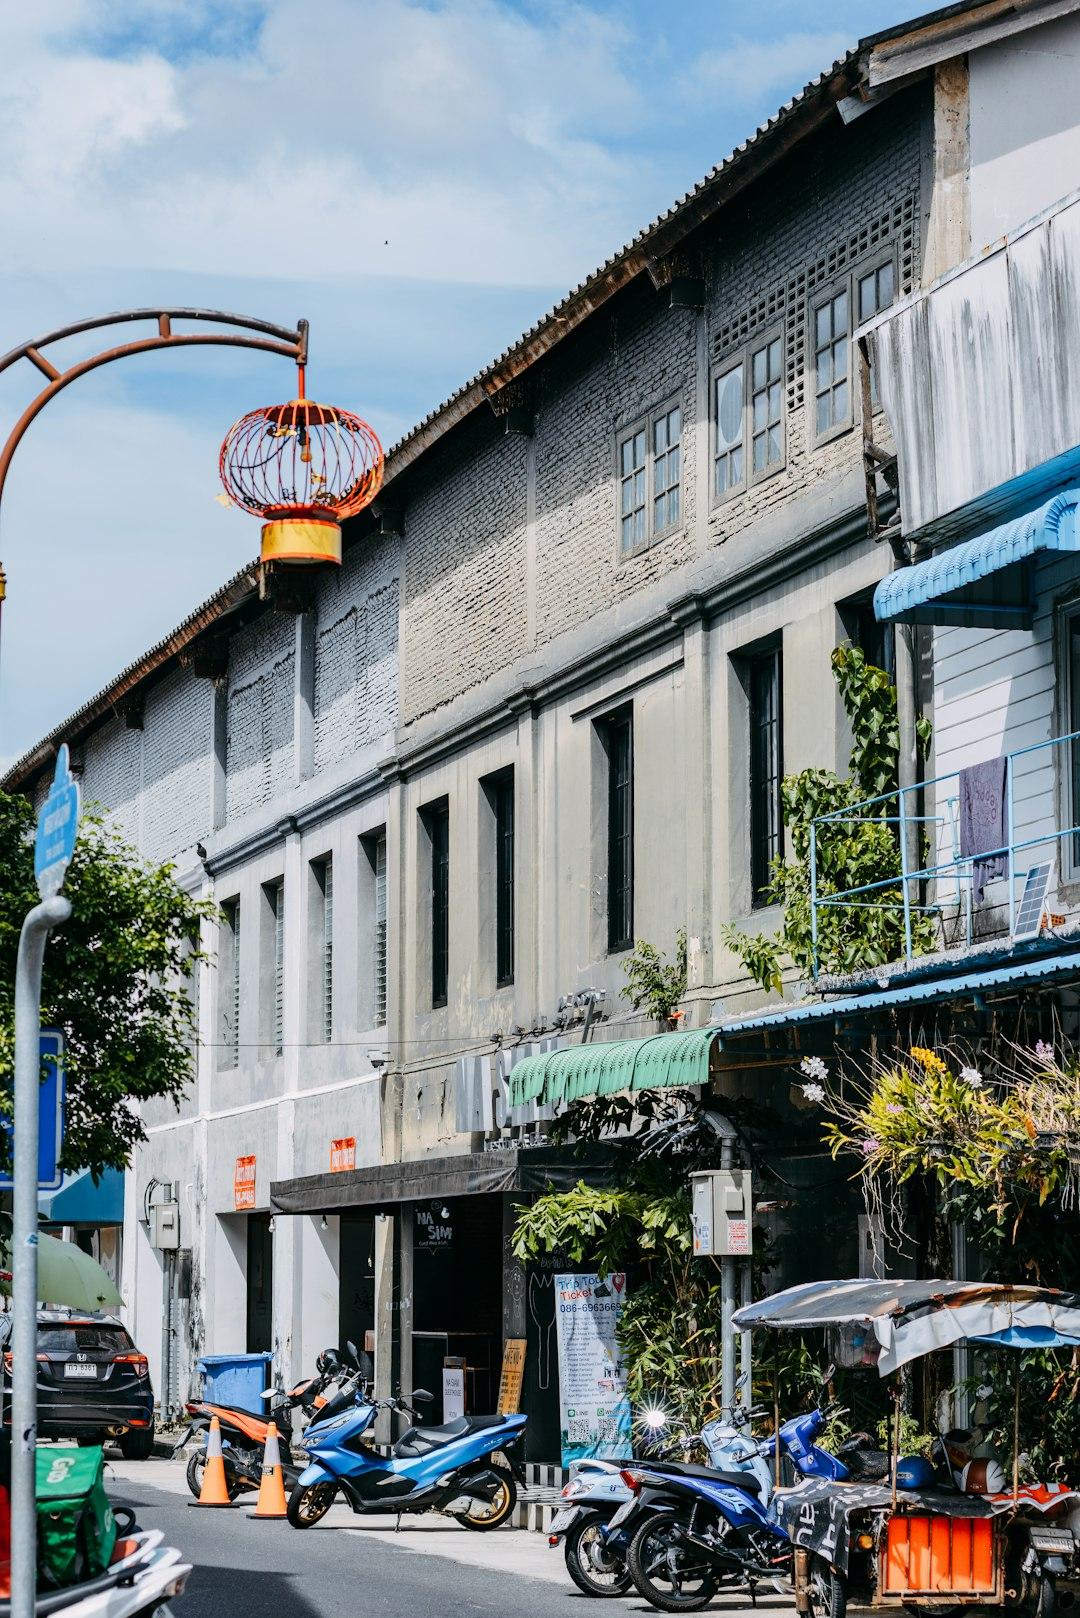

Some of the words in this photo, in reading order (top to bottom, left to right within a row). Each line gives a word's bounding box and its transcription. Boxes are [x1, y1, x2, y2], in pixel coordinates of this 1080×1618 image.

[559, 1279, 580, 1290] Trip
[582, 1276, 604, 1286] Tou
[560, 1288, 592, 1300] Ticket
[560, 1303, 622, 1313] 086-6963669
